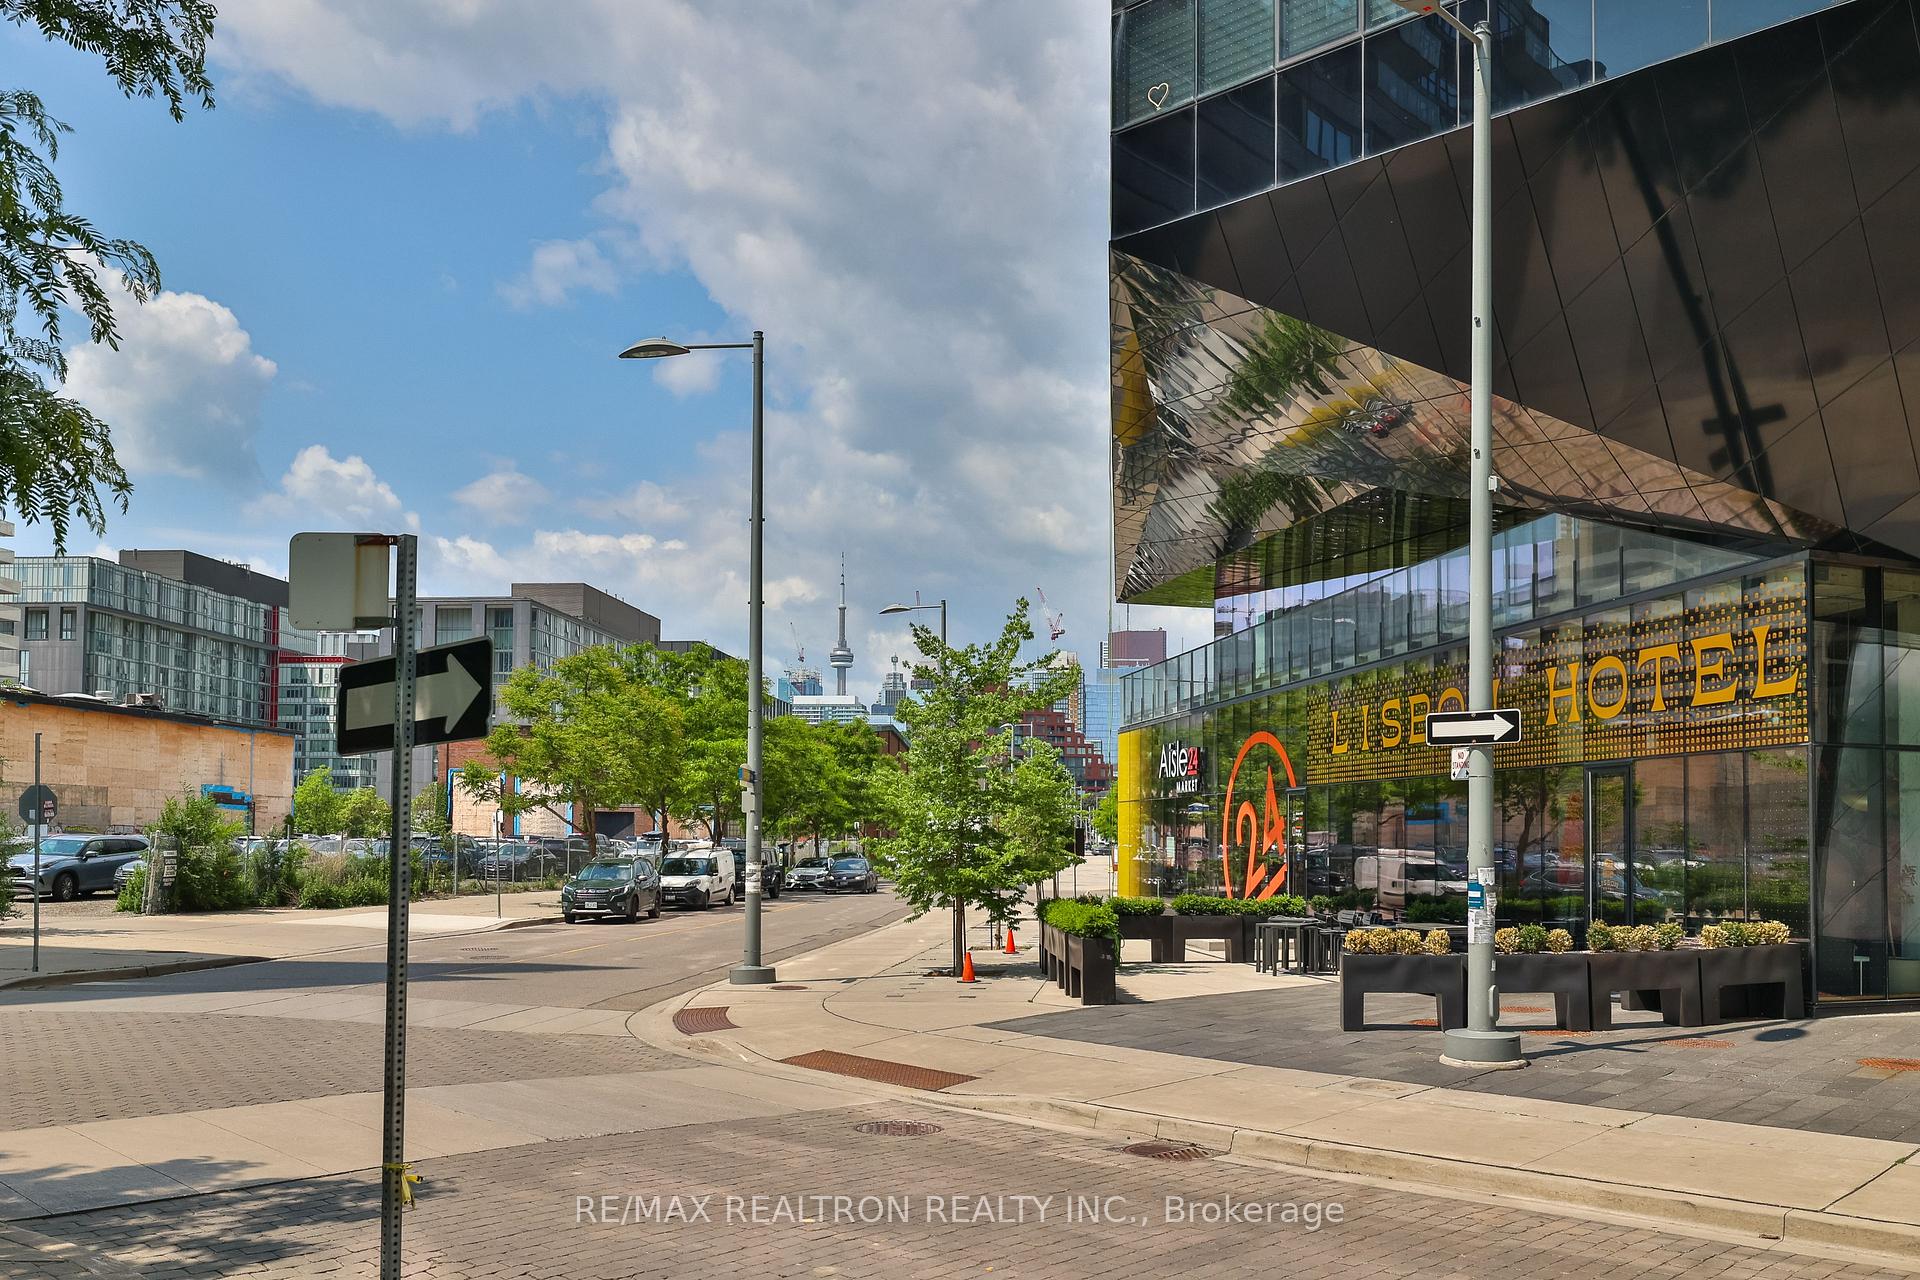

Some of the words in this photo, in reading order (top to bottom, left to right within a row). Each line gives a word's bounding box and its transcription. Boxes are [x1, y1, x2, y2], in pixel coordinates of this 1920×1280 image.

[1331, 679, 1500, 754] LISB
[1545, 624, 1799, 726] HOTEL
[1158, 739, 1198, 779] Aisle24
[1457, 751, 1465, 760] NO
[1176, 778, 1198, 793] MARKET
